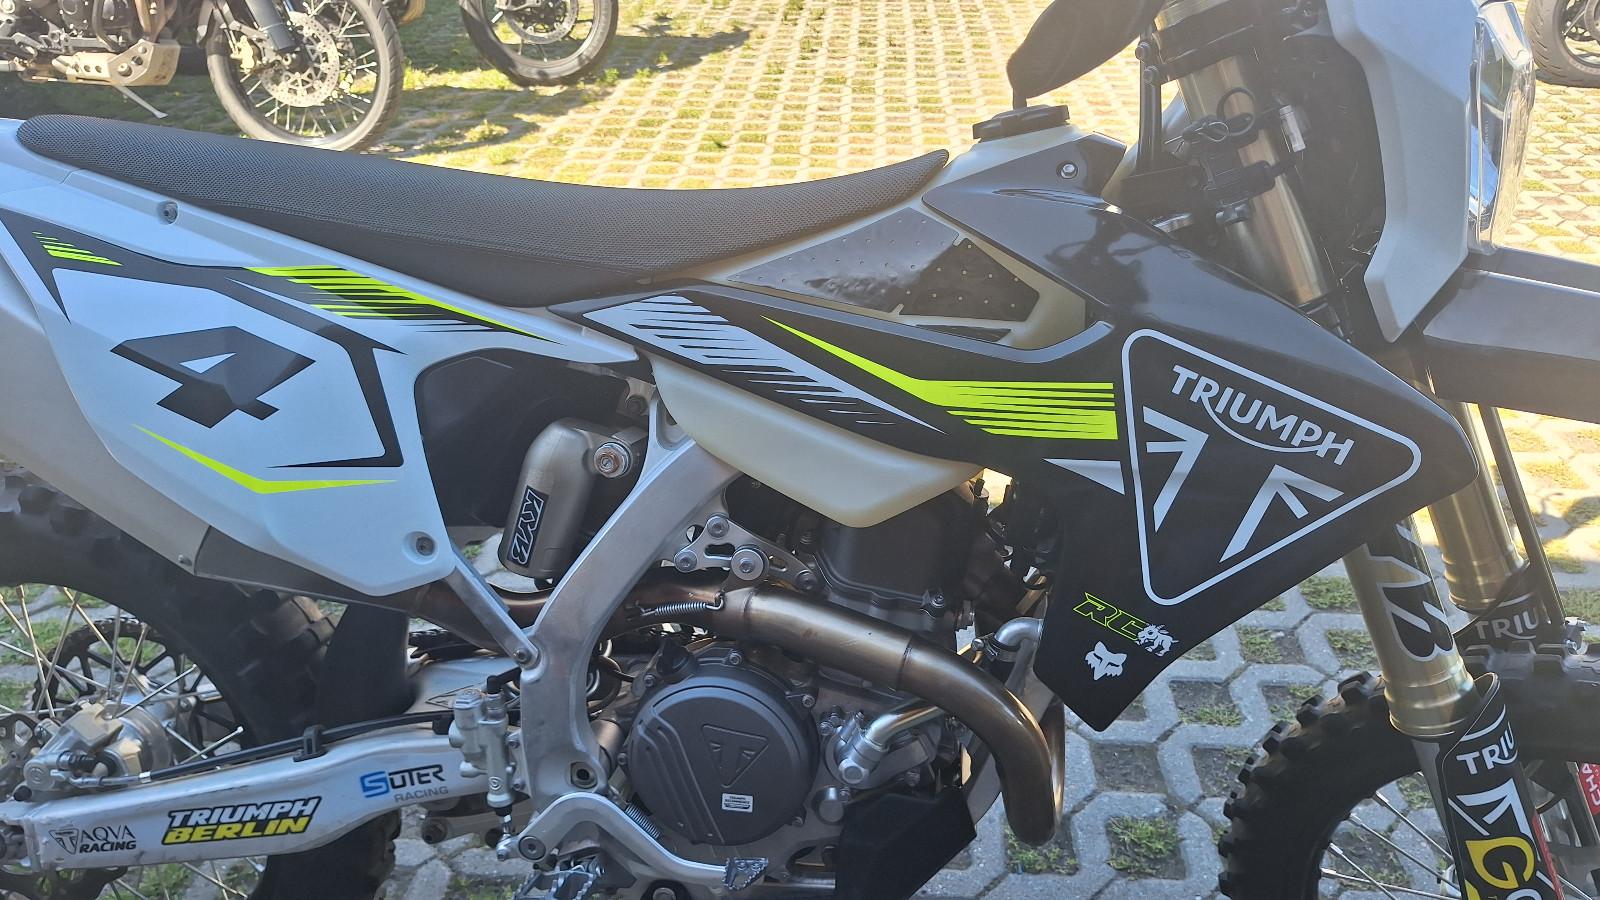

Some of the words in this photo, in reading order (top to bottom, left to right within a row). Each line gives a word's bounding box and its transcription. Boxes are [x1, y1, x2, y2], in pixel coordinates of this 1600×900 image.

[110, 326, 316, 429] 4
[1171, 364, 1355, 466] TRIUMPH
[511, 488, 544, 565] KYB
[360, 764, 446, 798] SUTER
[394, 786, 449, 802] RACING
[169, 798, 321, 828] TRIUMPH
[81, 825, 136, 843] AQVA
[163, 815, 311, 844] BERLIN
[80, 840, 137, 853] RACING
